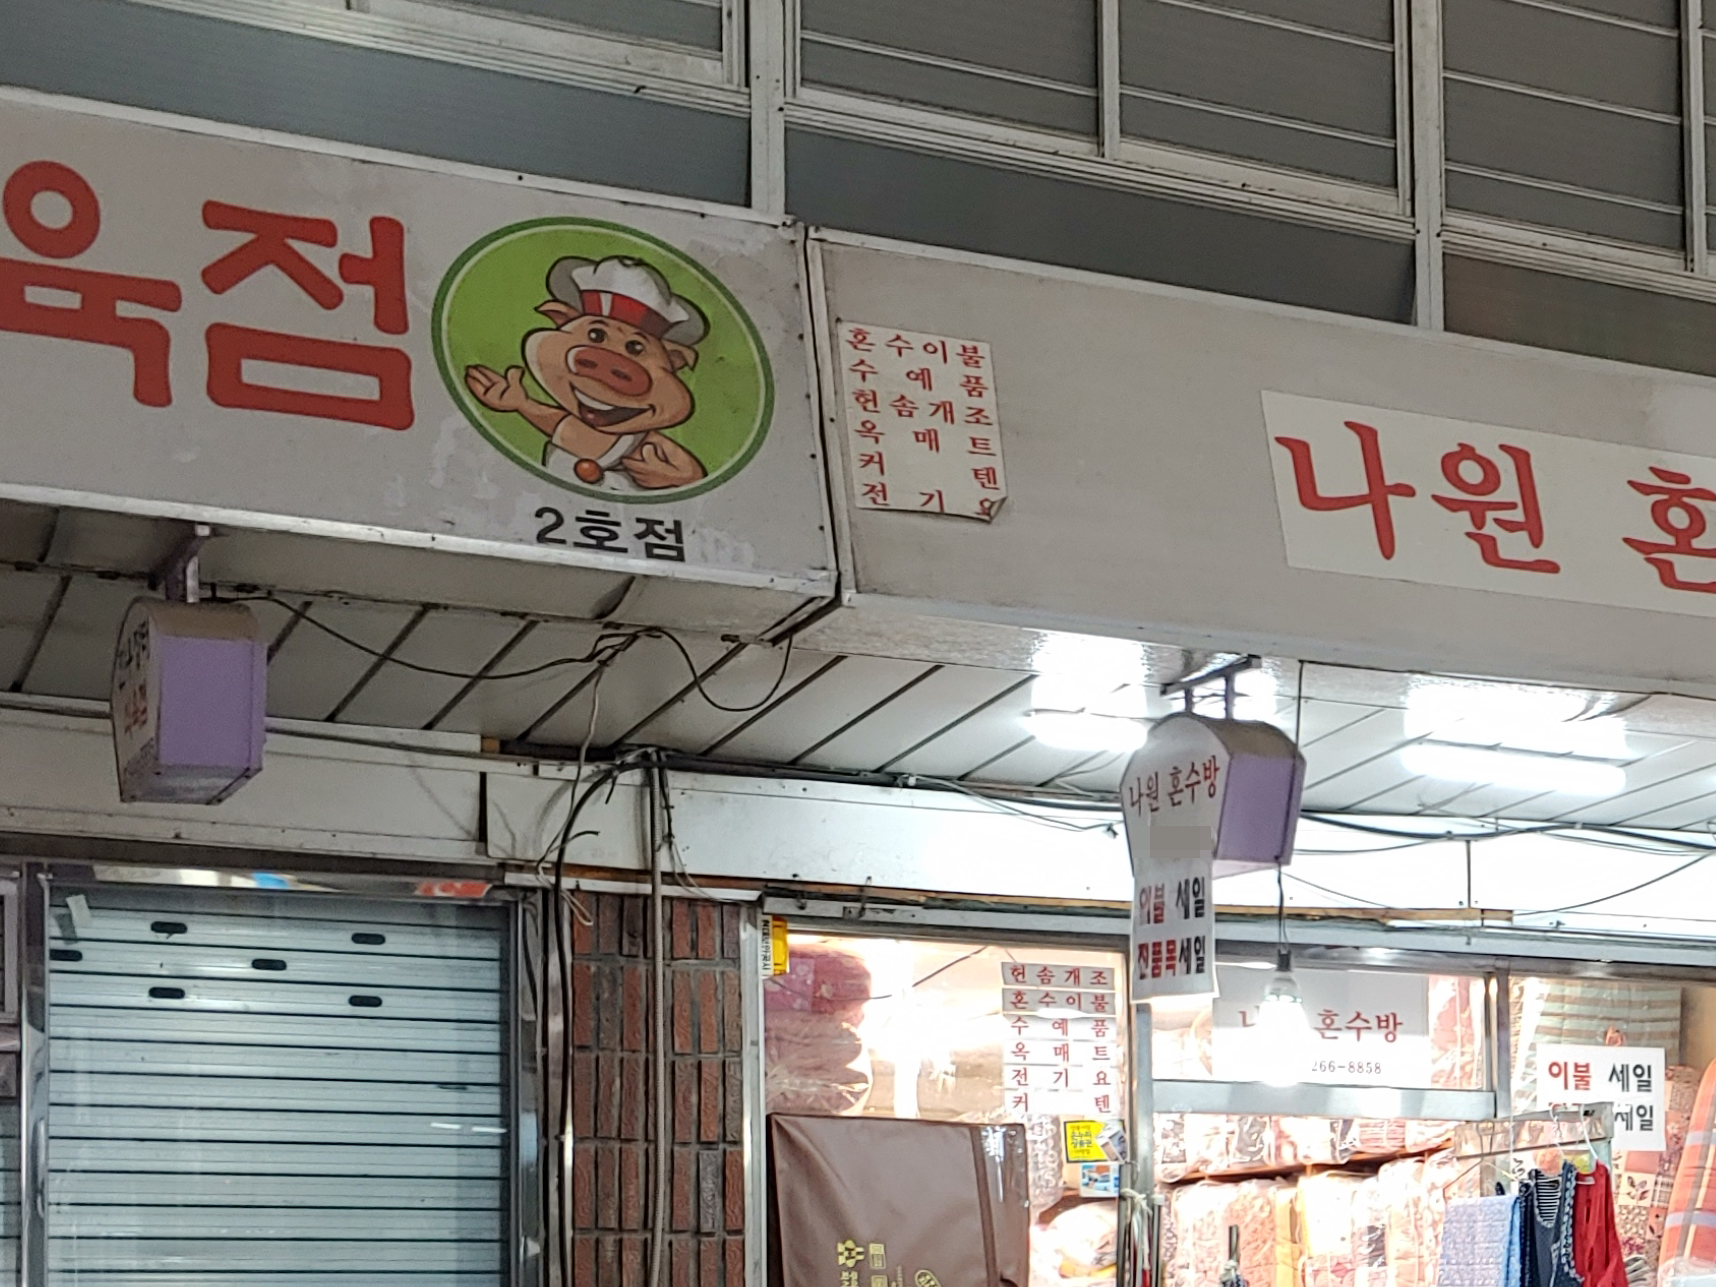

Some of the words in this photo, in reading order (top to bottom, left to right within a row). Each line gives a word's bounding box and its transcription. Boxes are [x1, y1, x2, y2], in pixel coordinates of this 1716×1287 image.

[0, 160, 415, 430] 육점
[846, 327, 986, 369] 혼수이불
[853, 388, 993, 426] 헌솜개조
[1275, 420, 1561, 576] 나원
[535, 505, 686, 563] 2호점
[1128, 771, 1161, 814] 나원
[1167, 754, 1220, 806] 혼수방
[1139, 882, 1165, 925] 이불
[1175, 875, 1205, 920] 세일
[1008, 965, 1109, 988] 헌솜개조
[1010, 990, 1109, 1012] 혼수이불
[1313, 1008, 1404, 1044] 혼수방
[1547, 1061, 1592, 1091] 이불
[1608, 1062, 1653, 1093] 세일
